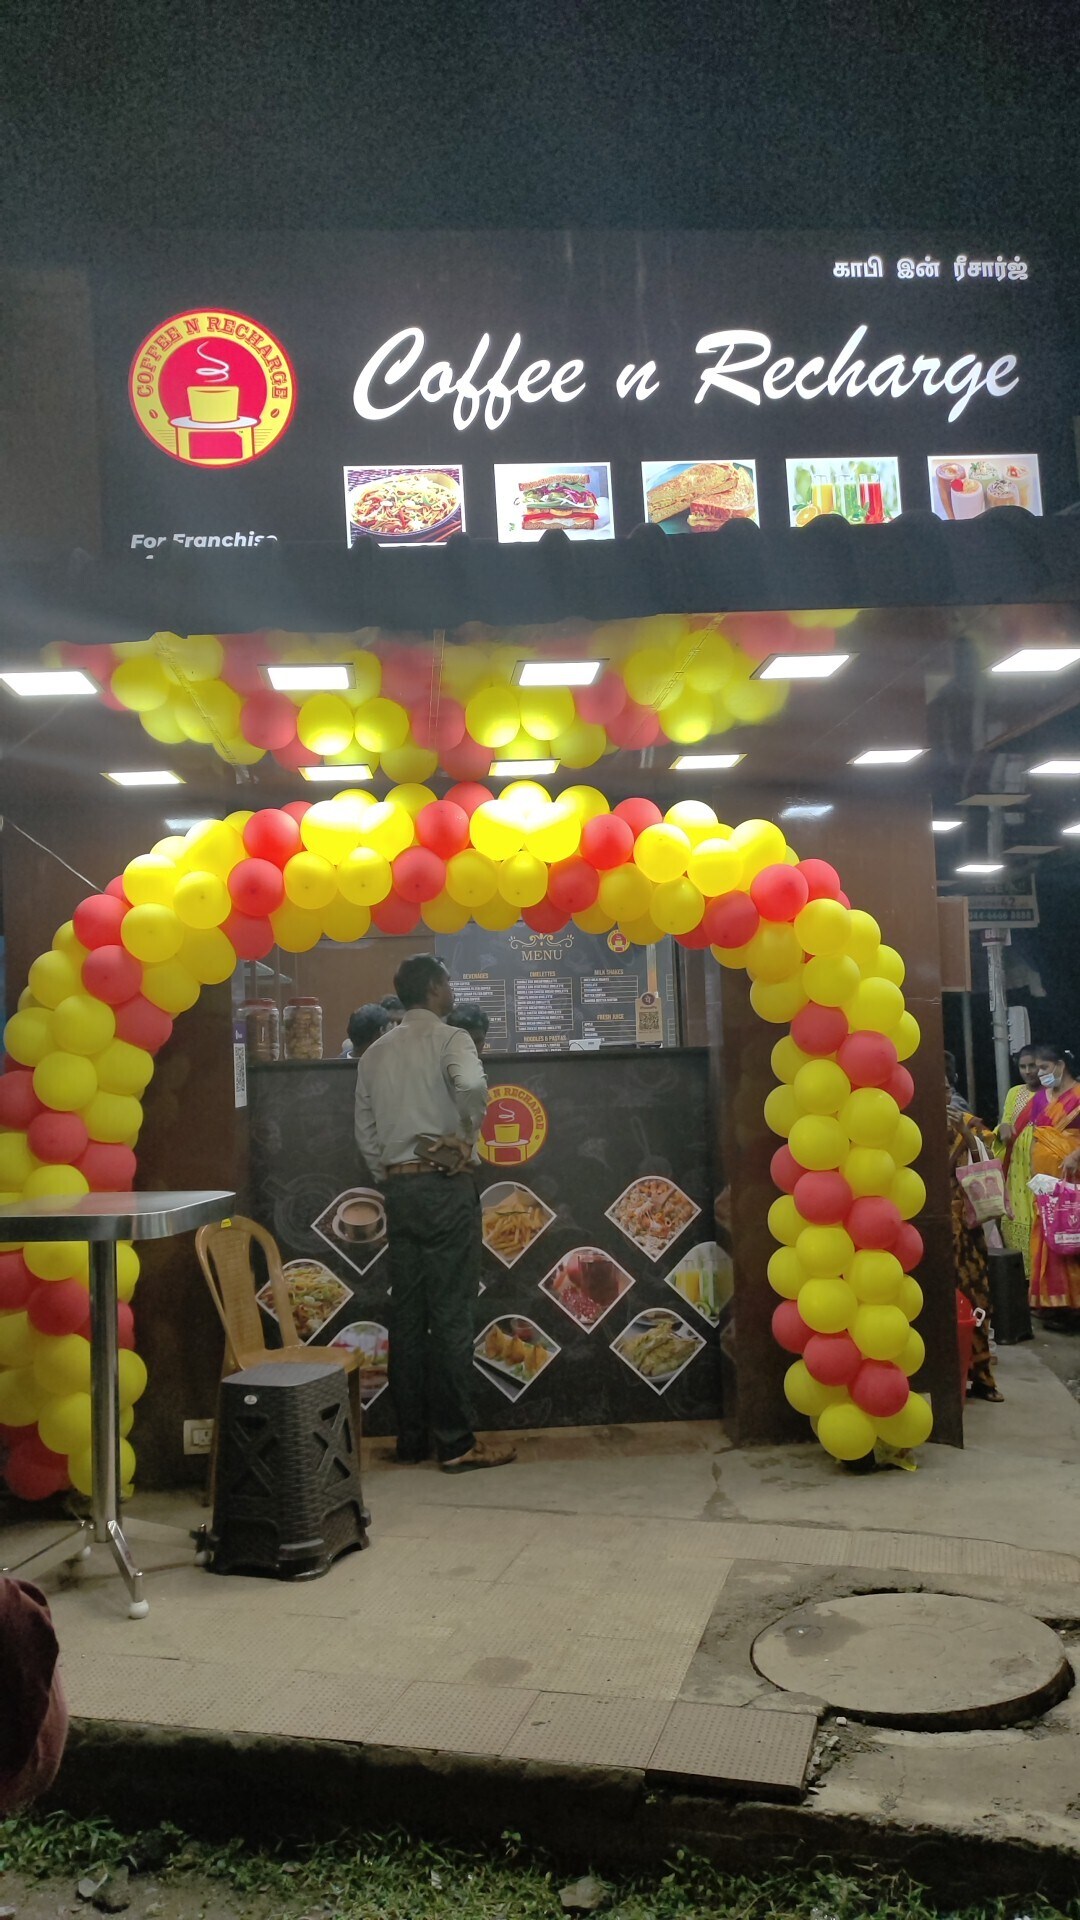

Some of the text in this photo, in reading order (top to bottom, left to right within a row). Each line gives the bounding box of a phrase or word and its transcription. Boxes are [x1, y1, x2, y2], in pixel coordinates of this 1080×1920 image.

[832, 255, 1029, 281] காபி இன் ரீசார்ஜ்
[137, 316, 288, 399] COFFEE N RECHARGE
[353, 325, 1020, 431] Coffee n Recharge
[130, 530, 278, 549] For Franchis
[521, 949, 563, 961] MENU
[503, 1087, 545, 1130] RECHARGE
